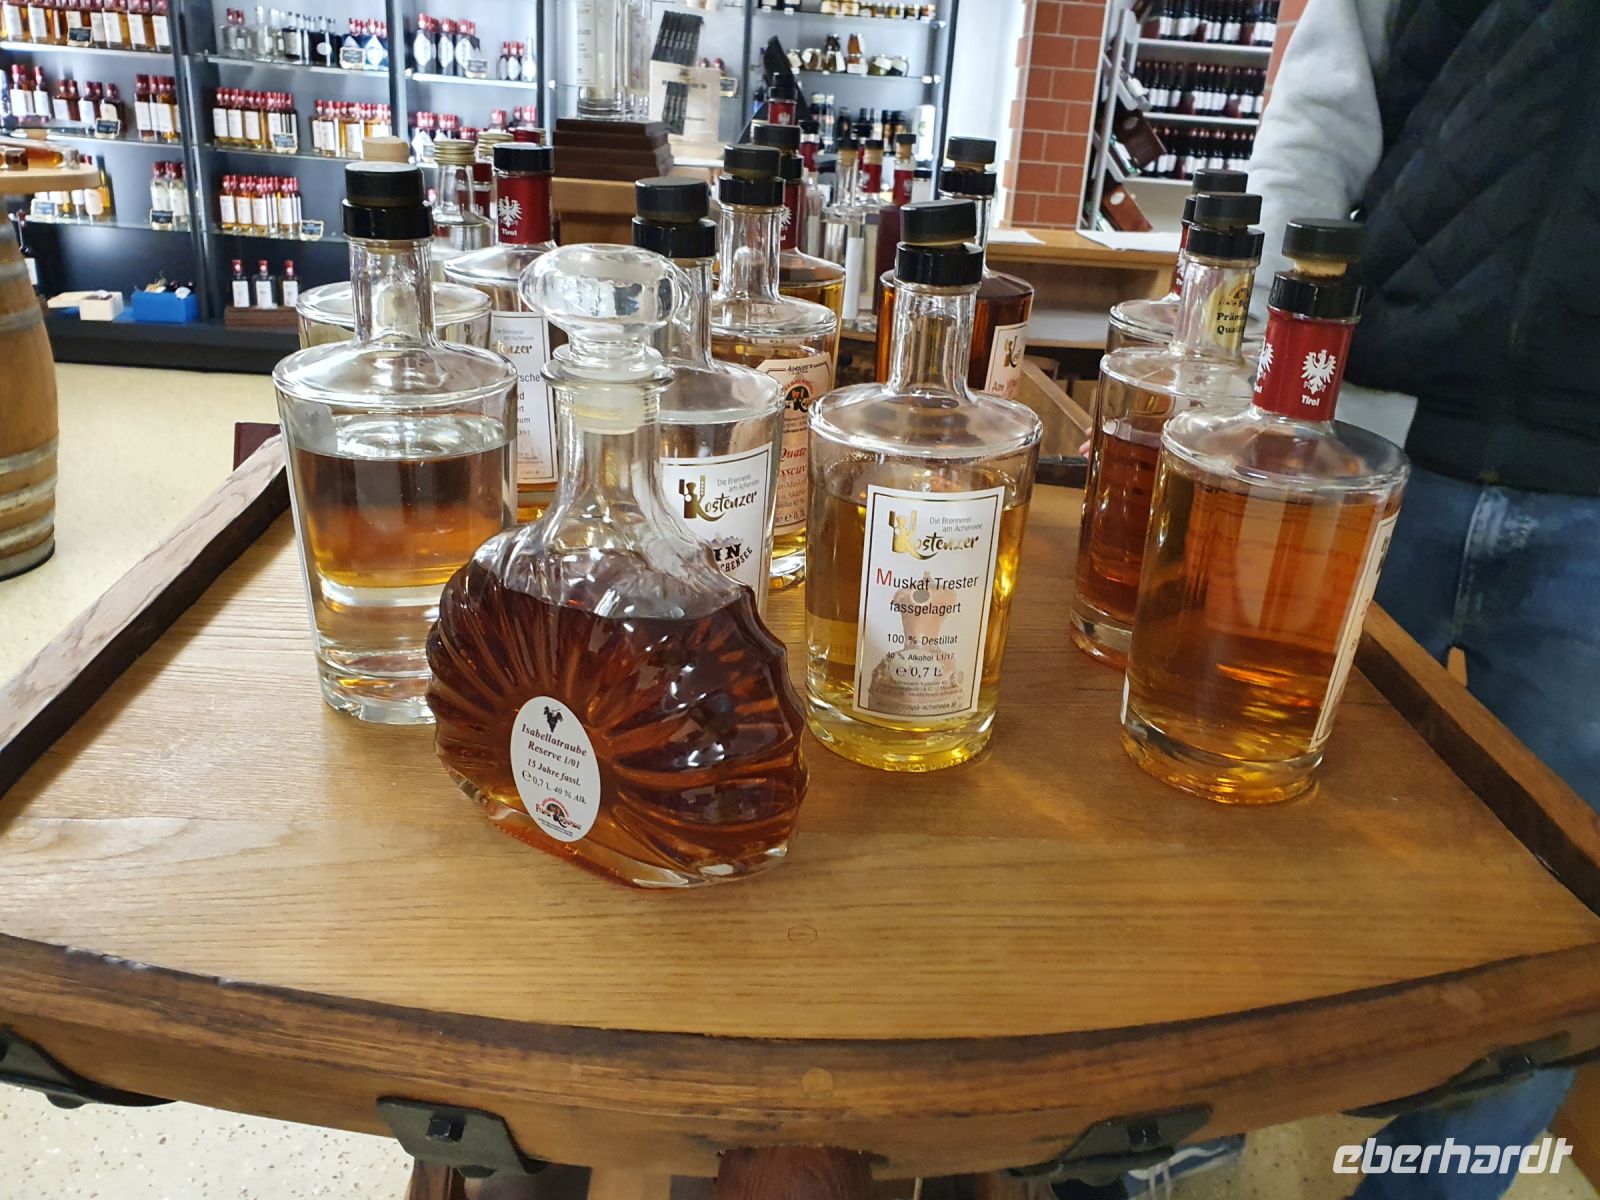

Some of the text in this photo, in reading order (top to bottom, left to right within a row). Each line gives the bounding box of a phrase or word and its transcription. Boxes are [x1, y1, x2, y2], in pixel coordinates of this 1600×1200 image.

[501, 228, 518, 236] Tirol
[1302, 395, 1320, 406] Tirol
[929, 516, 971, 525] Die Brennerei
[954, 523, 982, 532] Achensee
[713, 543, 741, 562] IN
[720, 546, 753, 572] CHENSEE
[876, 568, 979, 591] Muskat Trester
[890, 600, 961, 617] fassgelagert
[887, 633, 958, 646] 100 % Destillat
[886, 651, 895, 659] 40
[910, 666, 929, 678] 0,7
[522, 723, 587, 757] Isabellatraube
[528, 740, 580, 769] Reserve 1/01
[528, 758, 536, 768] 15
[537, 762, 559, 778] Jahre
